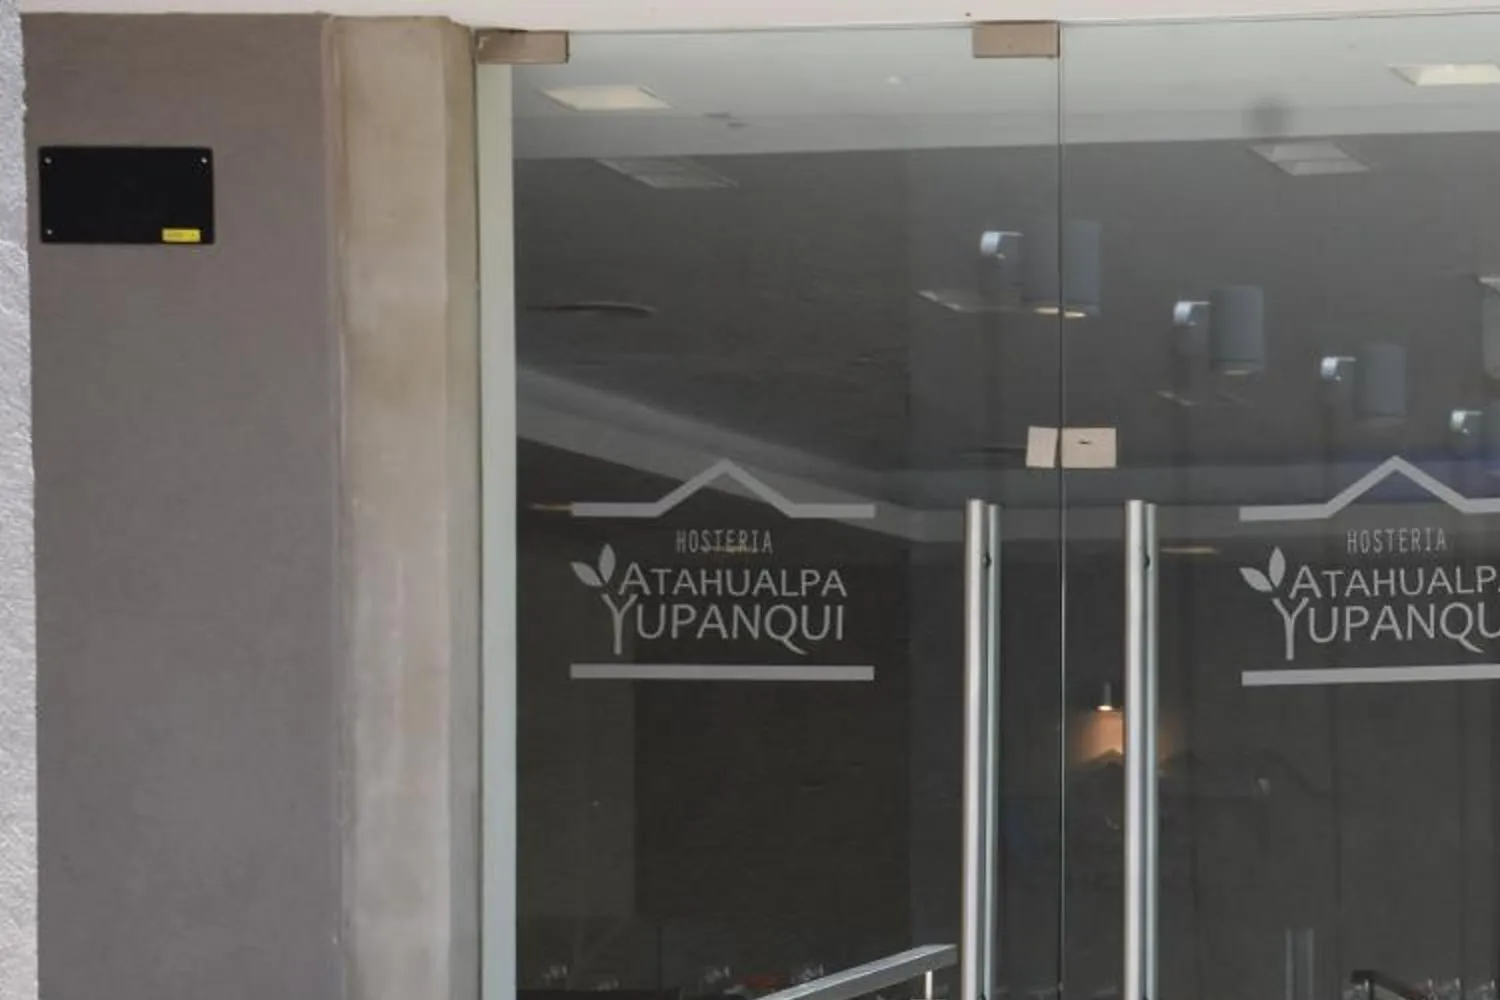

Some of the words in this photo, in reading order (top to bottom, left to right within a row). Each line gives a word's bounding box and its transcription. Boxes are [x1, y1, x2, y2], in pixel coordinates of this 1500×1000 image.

[676, 529, 773, 552] HOSTERIA
[1346, 527, 1447, 553] HOSTERIA
[618, 561, 847, 597] ATAHUALPA
[602, 594, 844, 655] YUPANQUI
